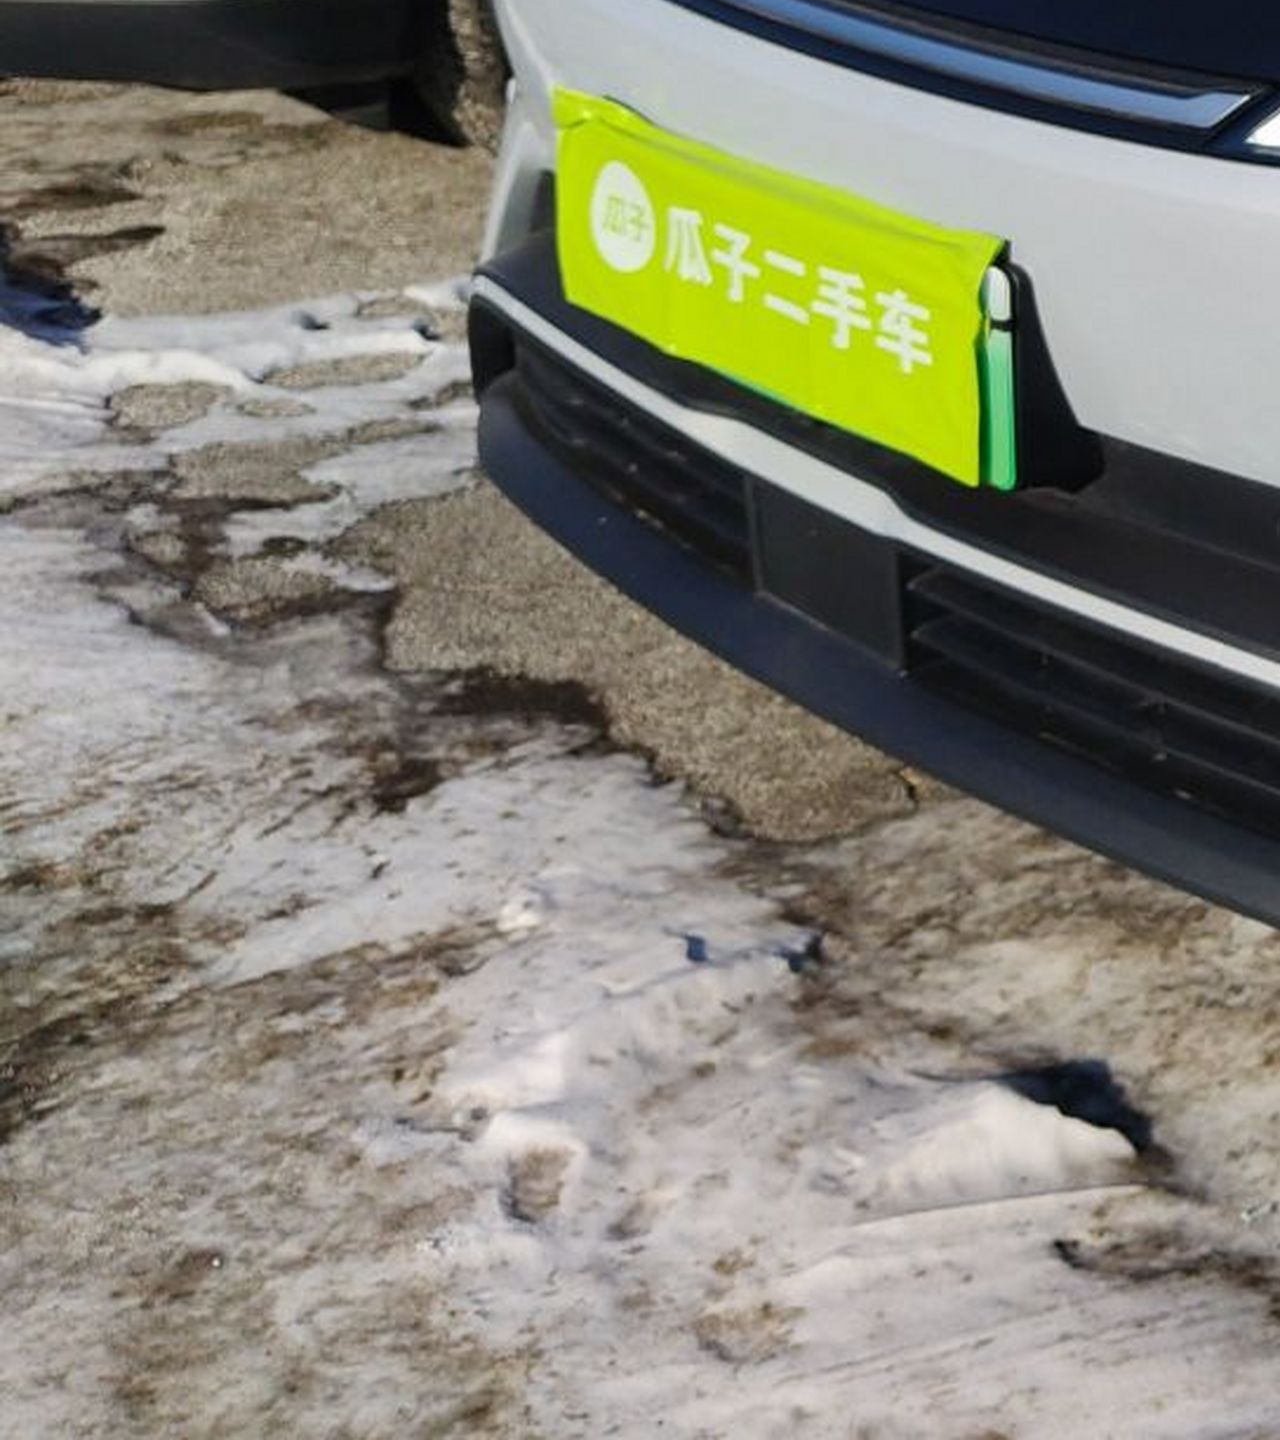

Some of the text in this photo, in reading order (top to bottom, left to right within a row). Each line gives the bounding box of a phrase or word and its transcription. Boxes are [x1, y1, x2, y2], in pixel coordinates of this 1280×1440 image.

[664, 206, 932, 374] 瓜子二手车
